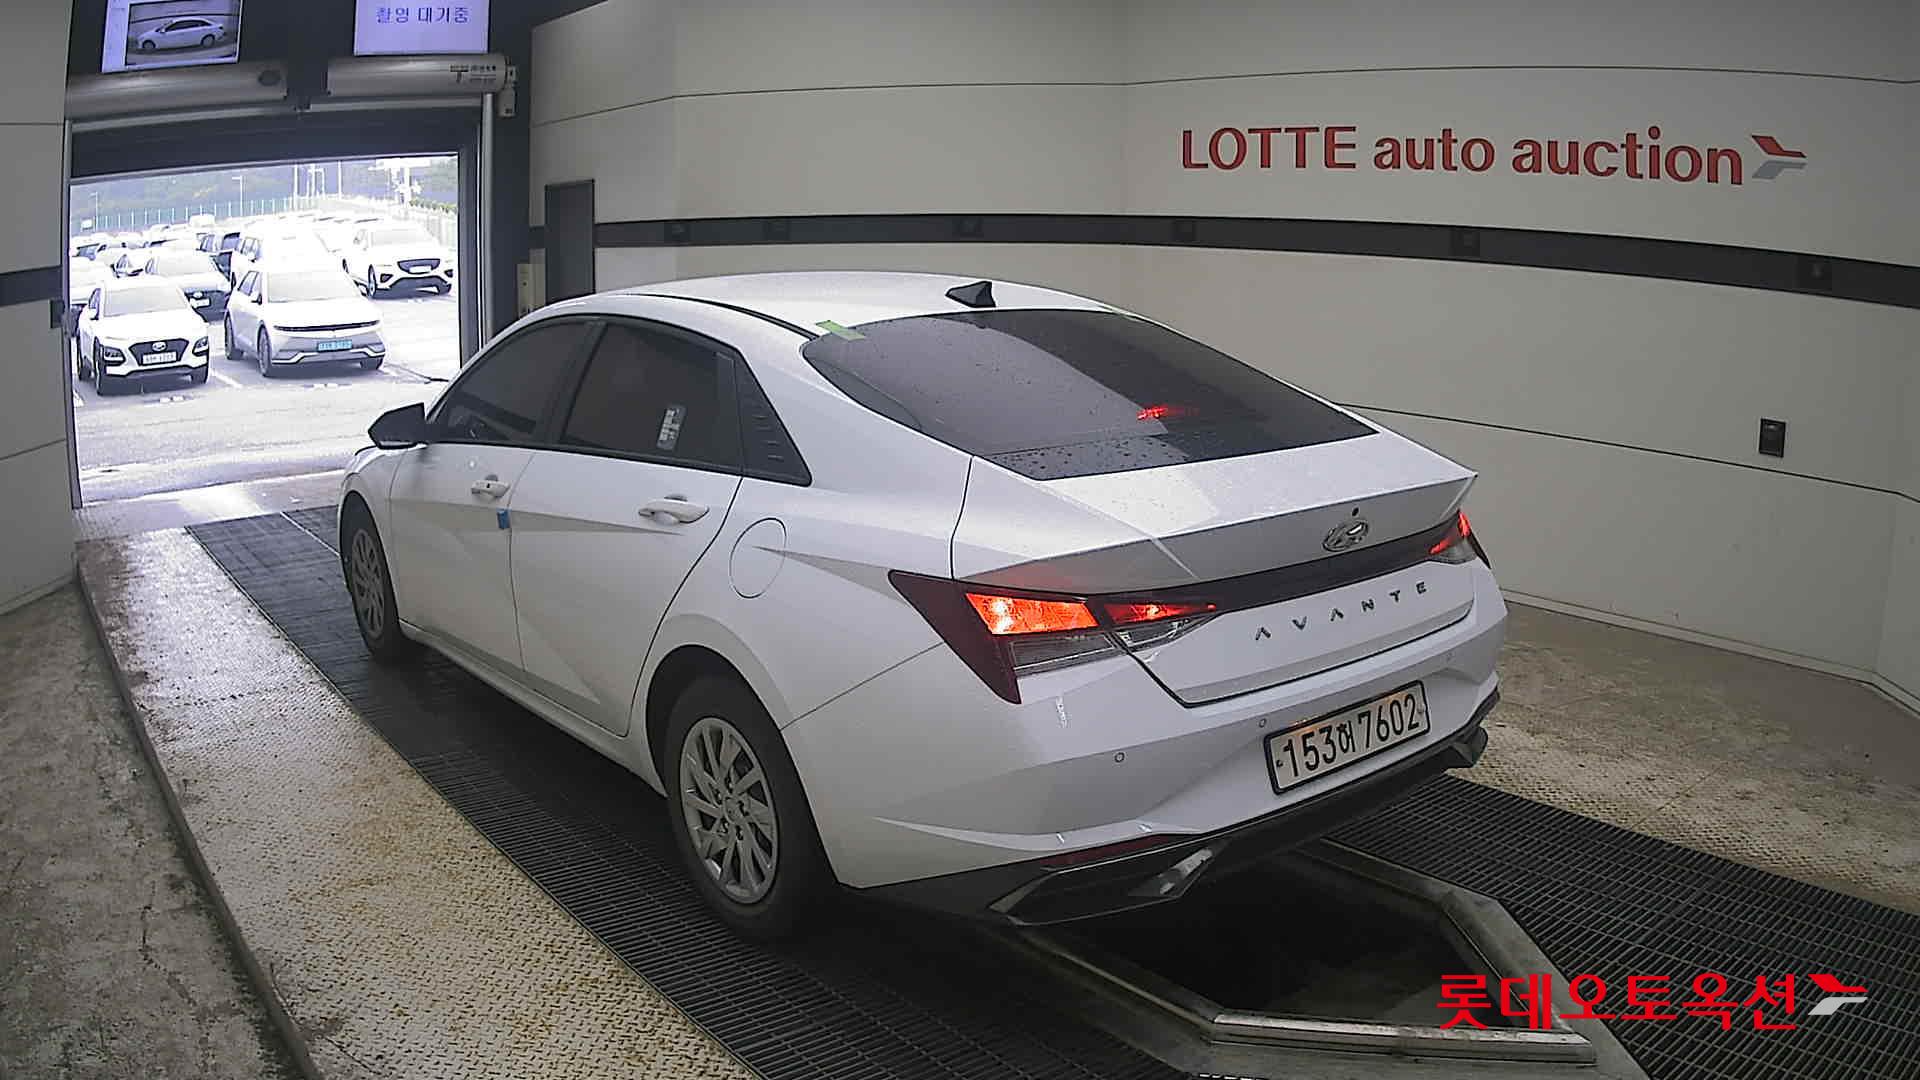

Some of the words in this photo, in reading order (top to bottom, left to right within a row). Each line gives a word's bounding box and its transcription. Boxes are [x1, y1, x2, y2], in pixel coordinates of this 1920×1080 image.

[417, 7, 470, 24] 대기중
[1182, 126, 1357, 170] LOTTE
[1373, 128, 1496, 172] auto
[1511, 125, 1743, 186] auction
[1254, 581, 1427, 641] AVANTE
